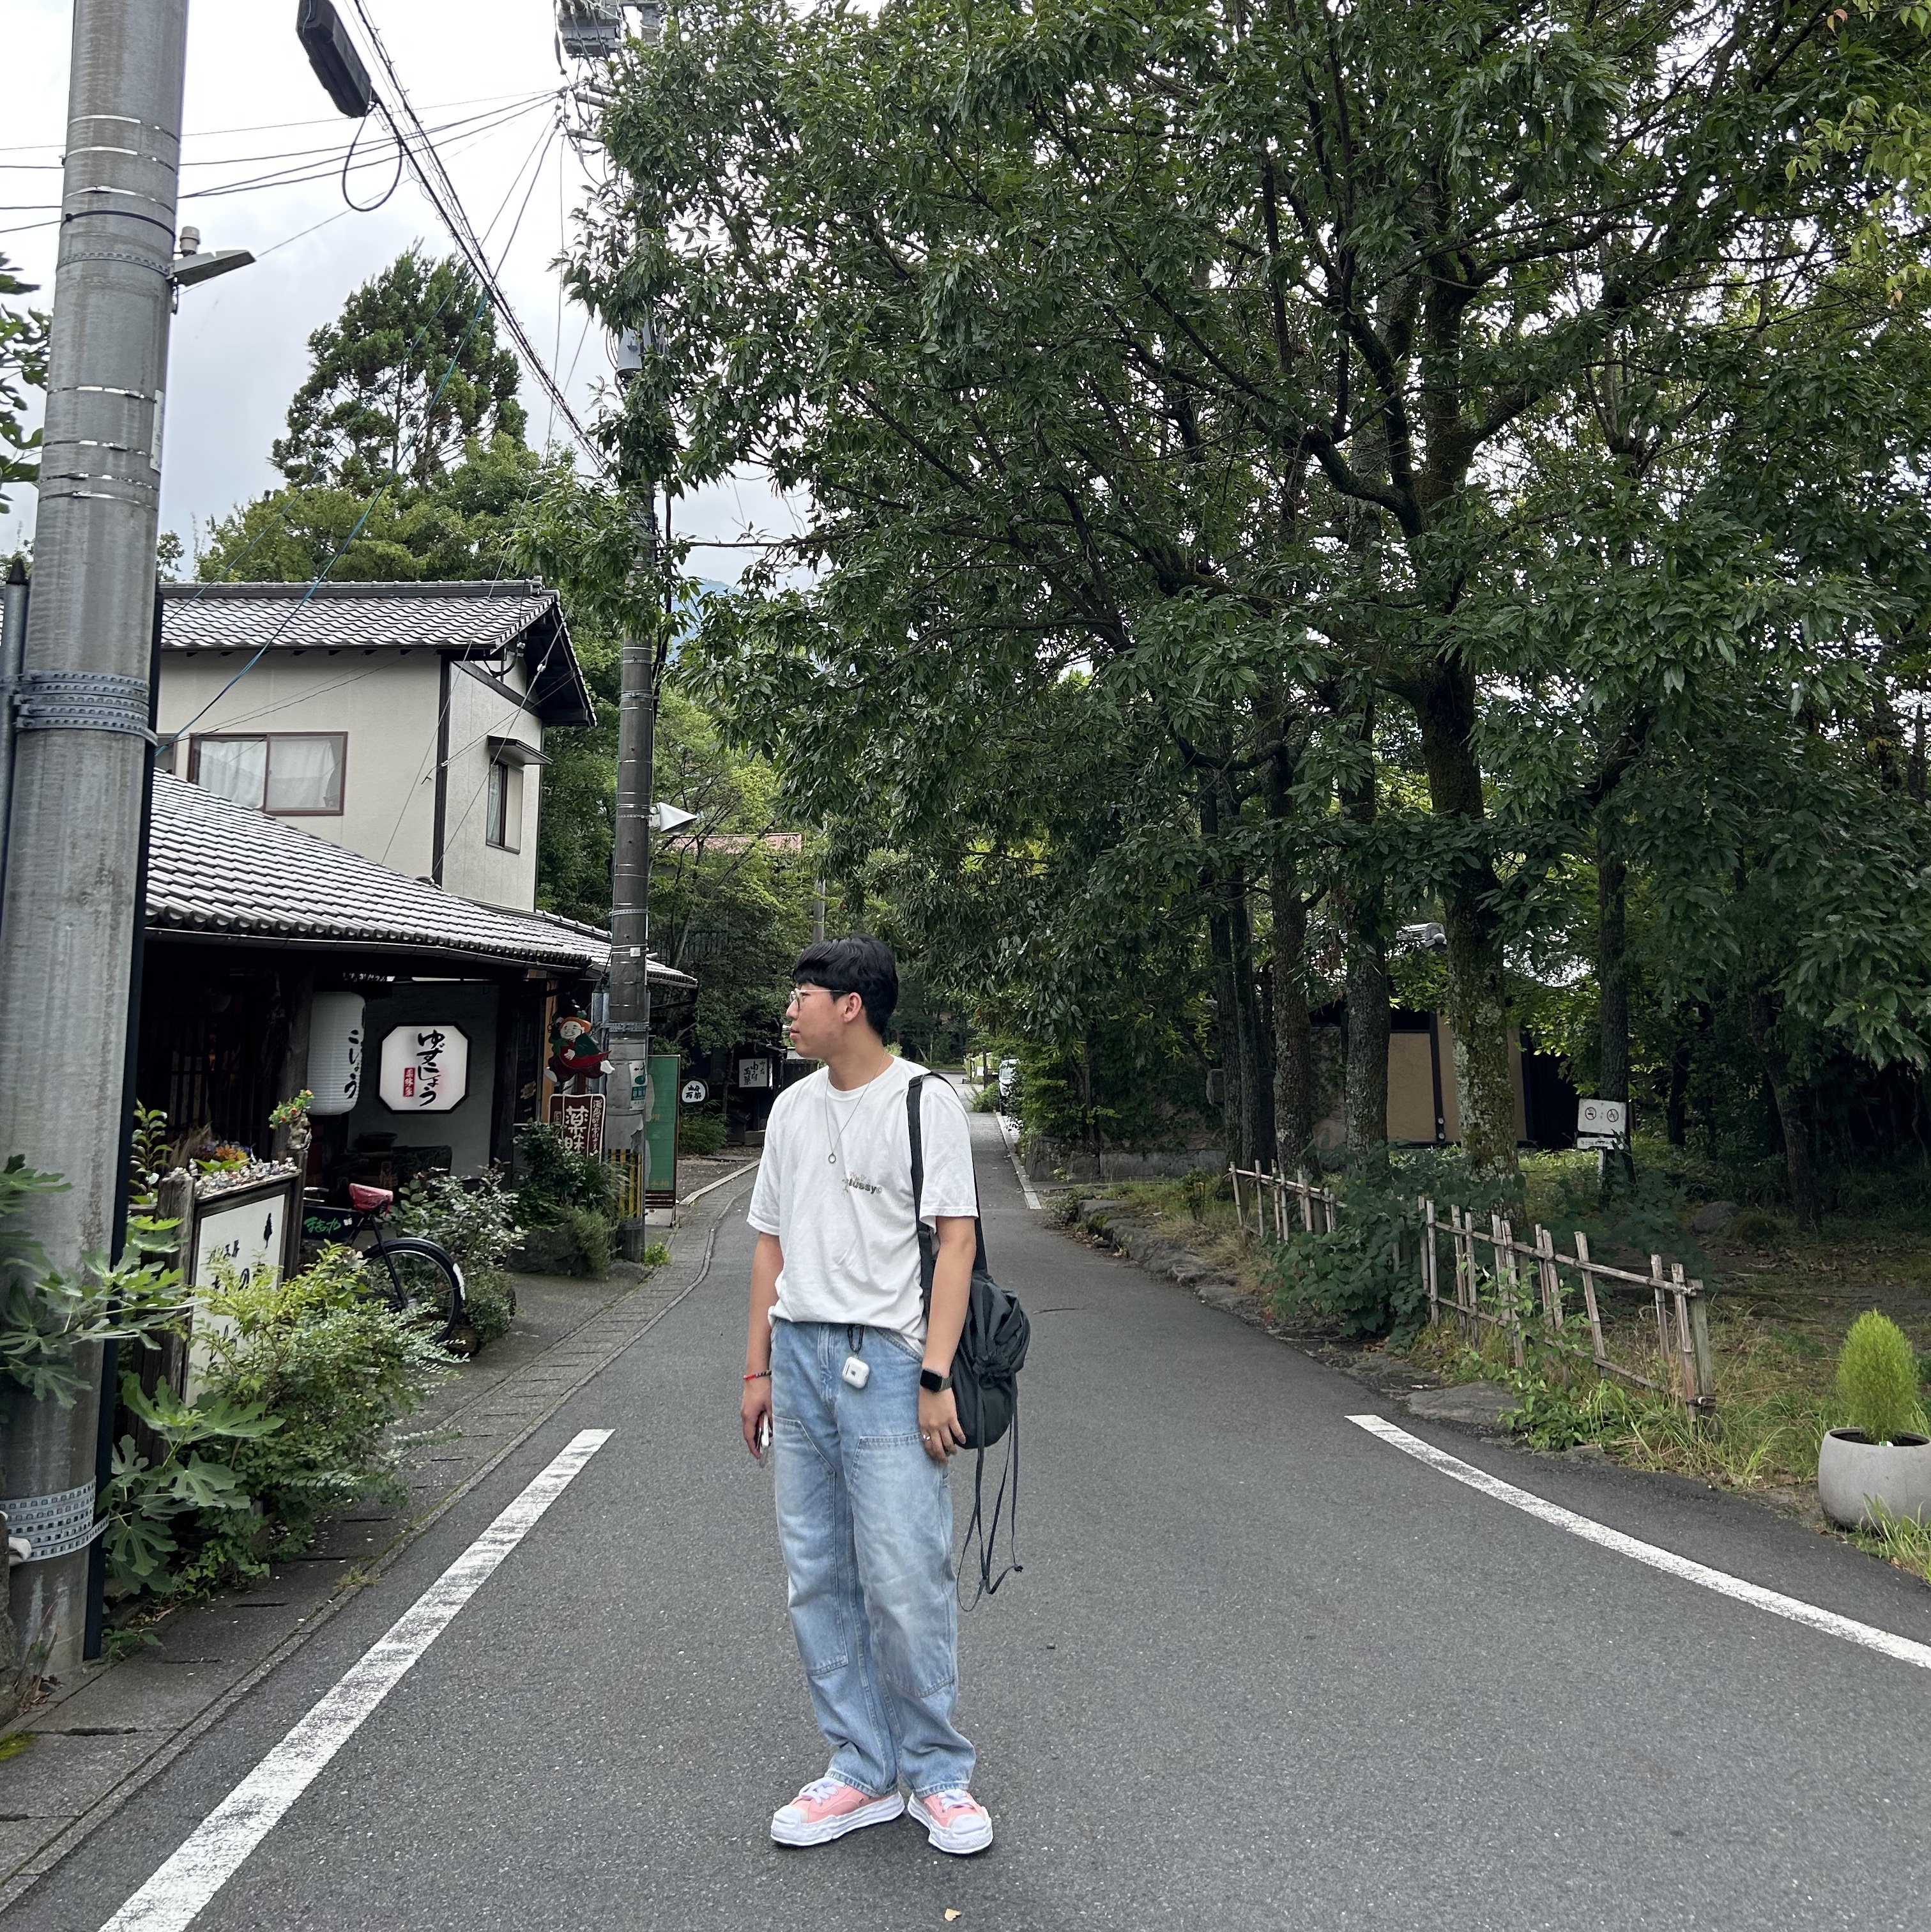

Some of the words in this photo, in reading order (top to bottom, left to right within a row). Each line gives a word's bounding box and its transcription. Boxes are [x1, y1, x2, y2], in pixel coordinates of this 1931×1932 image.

[416, 1029, 446, 1107] ゆずこしょう
